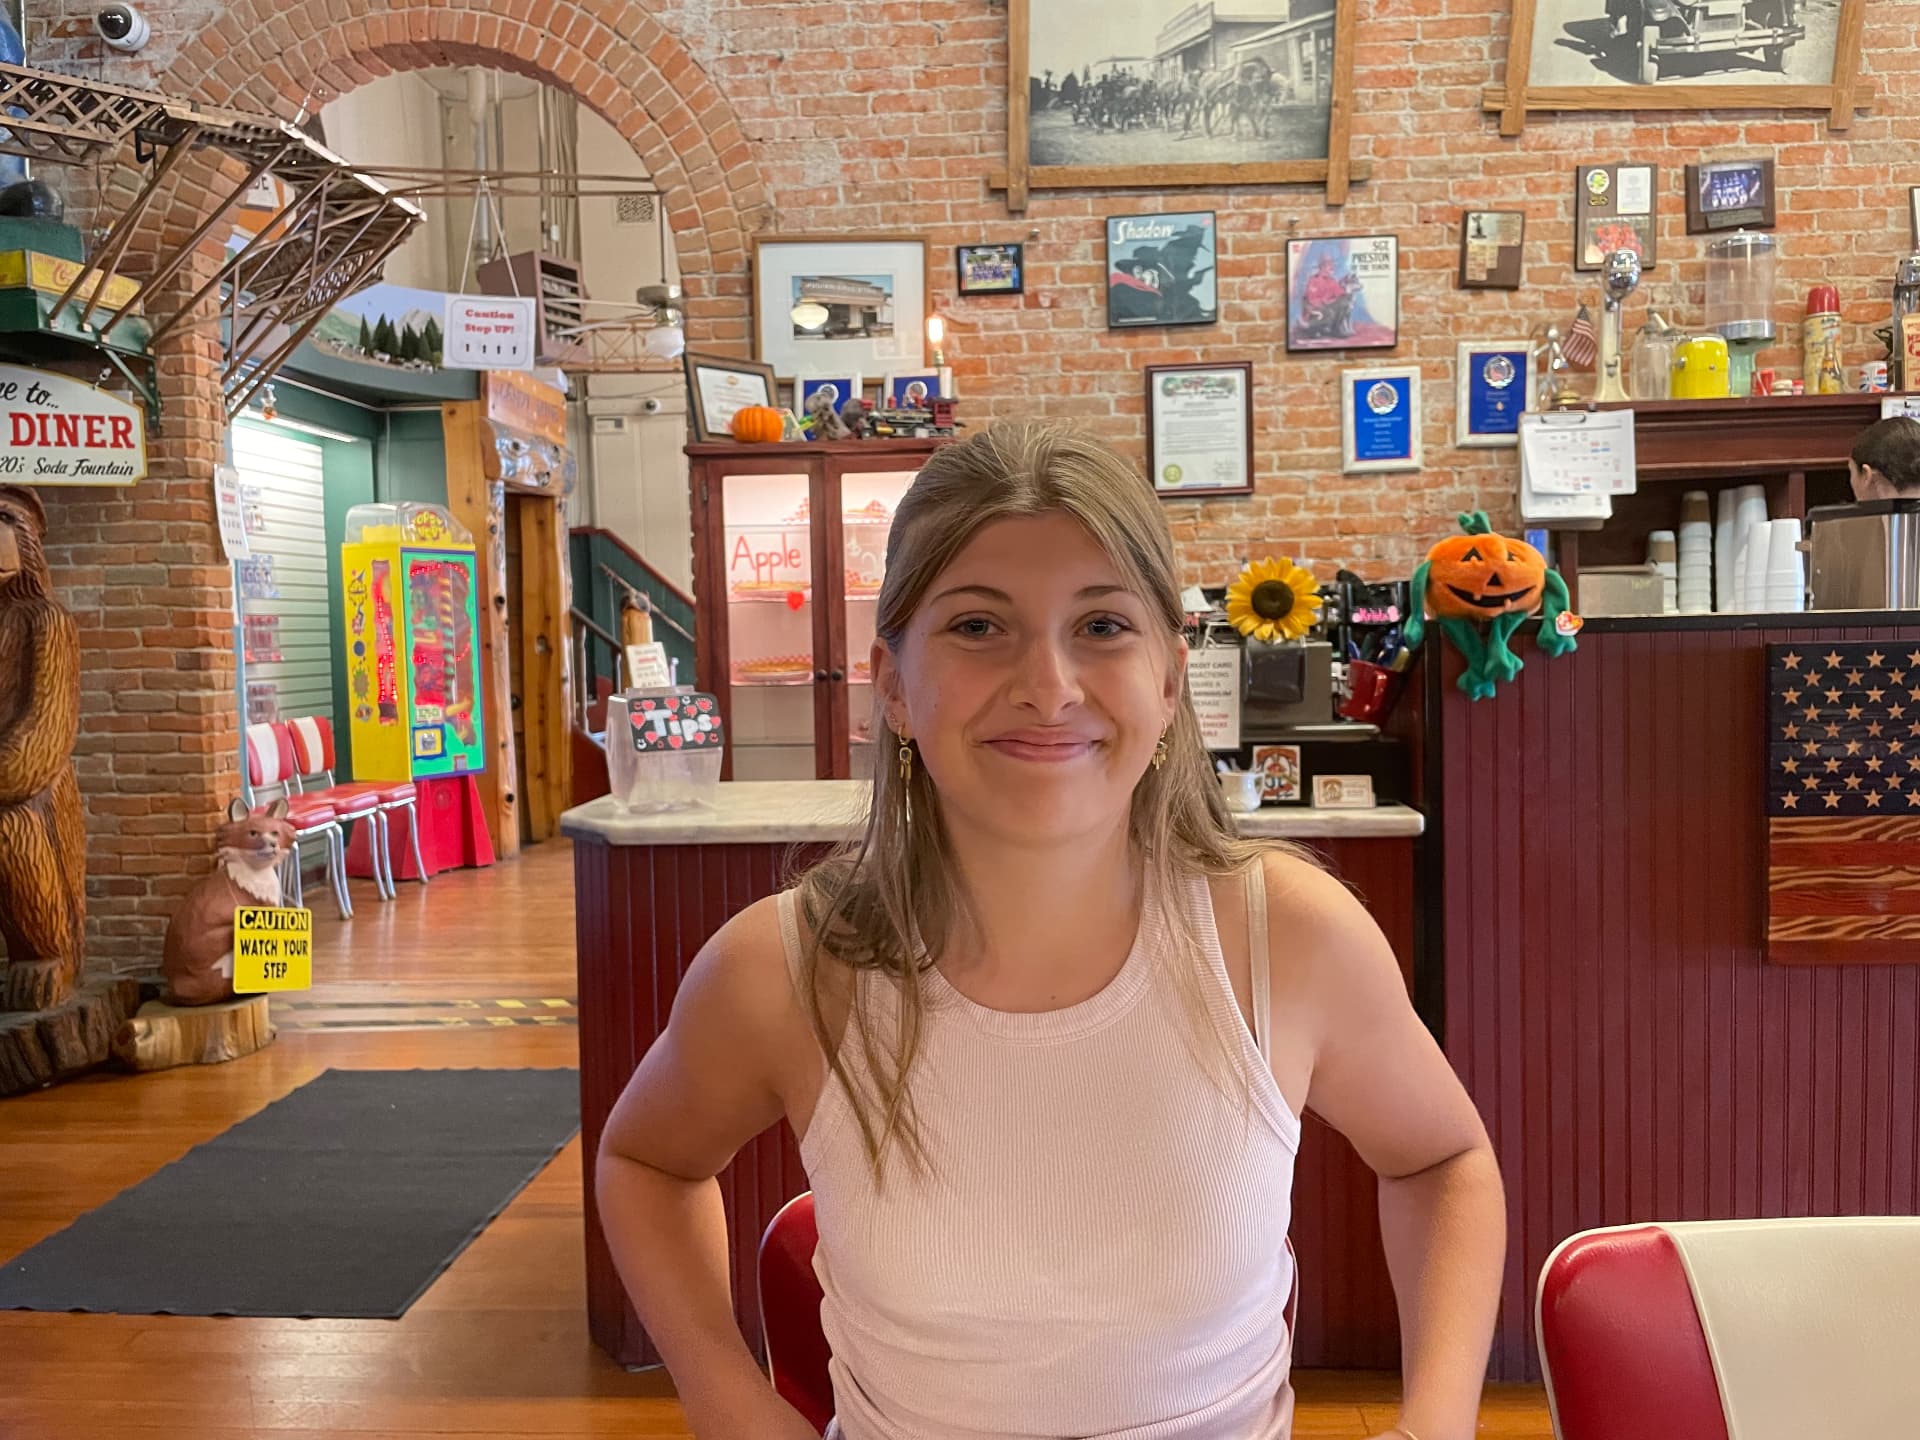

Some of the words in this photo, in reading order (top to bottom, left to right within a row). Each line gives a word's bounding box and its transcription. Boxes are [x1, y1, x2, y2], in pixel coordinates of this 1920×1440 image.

[1112, 219, 1175, 245] Shadow
[465, 309, 514, 319] Caution
[8, 411, 136, 449] DINER
[33, 457, 69, 475] Soda
[68, 458, 134, 477] Fountain
[731, 534, 802, 585] Apple
[241, 910, 308, 930] CAUTION
[240, 939, 278, 956] WATCH
[284, 940, 308, 956] YOUR
[264, 962, 287, 979] STEP
